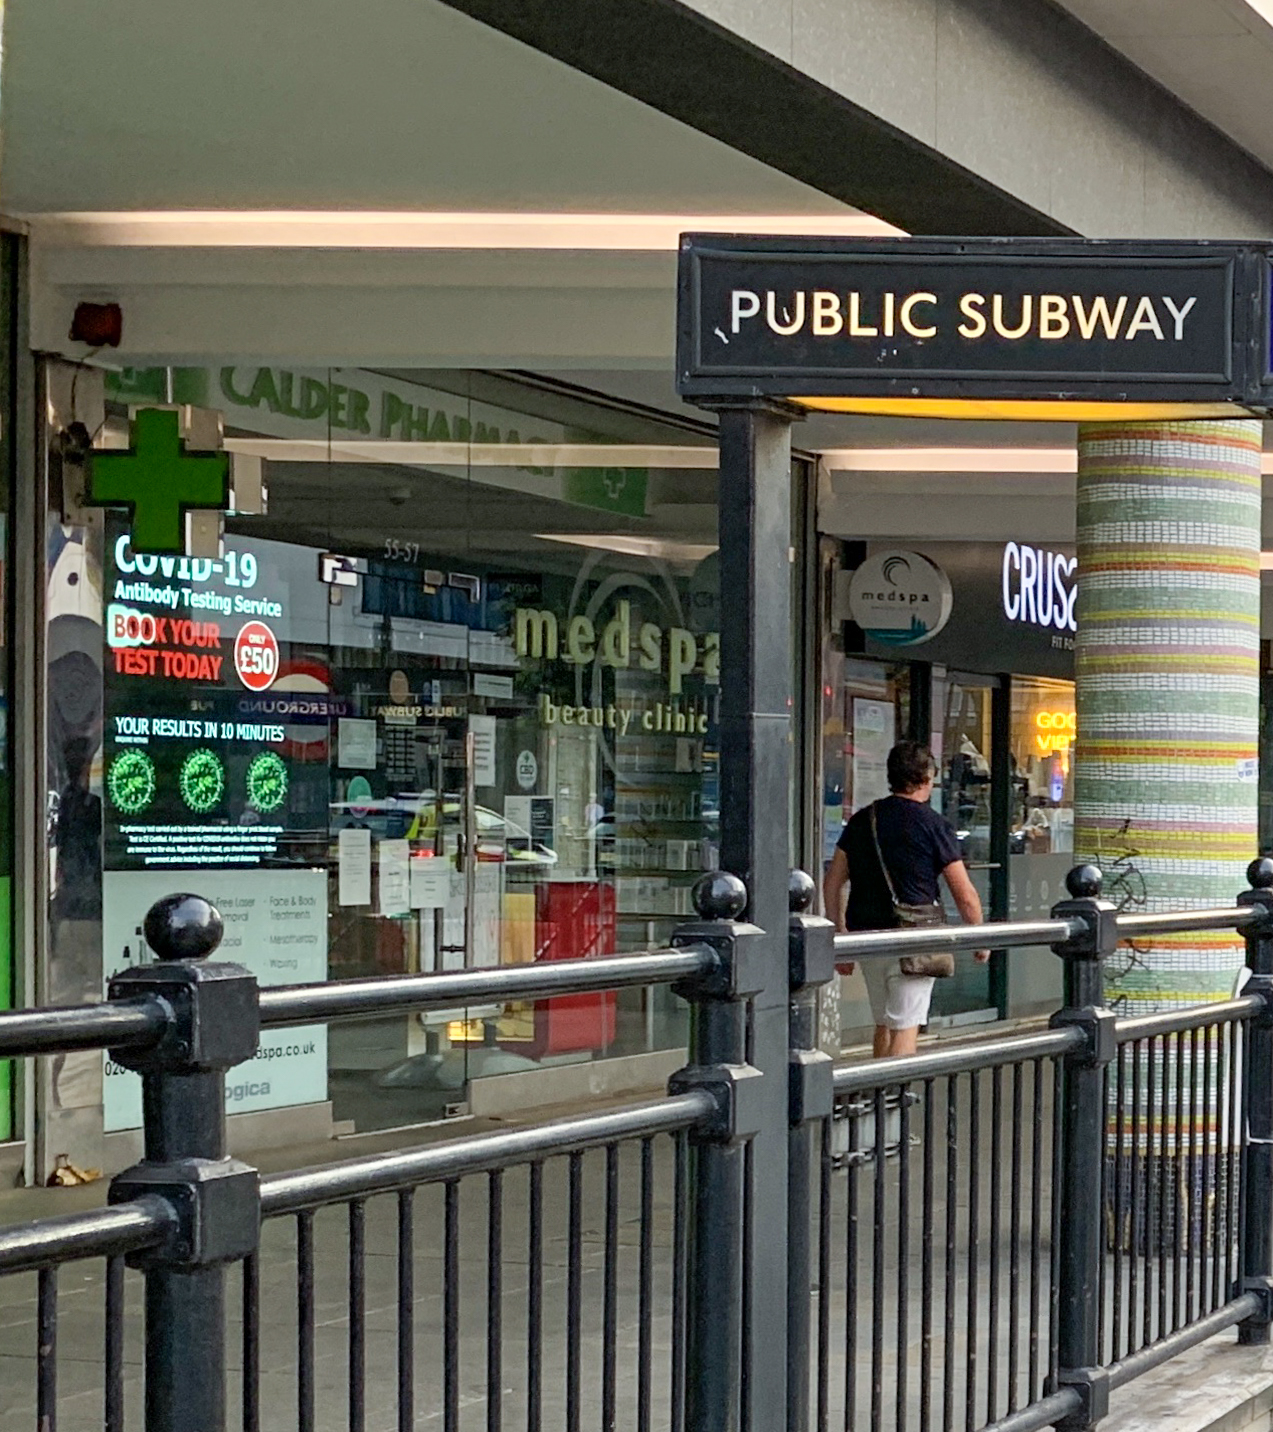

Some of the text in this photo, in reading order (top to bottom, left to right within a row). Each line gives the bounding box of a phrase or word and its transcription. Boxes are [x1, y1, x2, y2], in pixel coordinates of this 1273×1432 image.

[731, 290, 1198, 341] PUBLIC SUBWAY
[220, 366, 371, 435] CALDER
[115, 535, 257, 588] COVID-19
[115, 580, 282, 617] Antibody Testing Service
[862, 591, 929, 605] medspa
[114, 612, 221, 648] BOOK YOUR
[241, 646, 273, 676] £50
[516, 600, 720, 694] medspa
[112, 648, 223, 681] TEST TODAY
[115, 717, 284, 742] YOUR RESULTS IN 10 MINUTES
[543, 694, 708, 736] beauty clinic
[270, 896, 290, 907] Face
[299, 896, 316, 908] Body
[270, 910, 311, 920] Treatments
[220, 936, 242, 948] acial
[252, 1041, 316, 1062] dspa.co.uk
[225, 1080, 270, 1100] ogica
